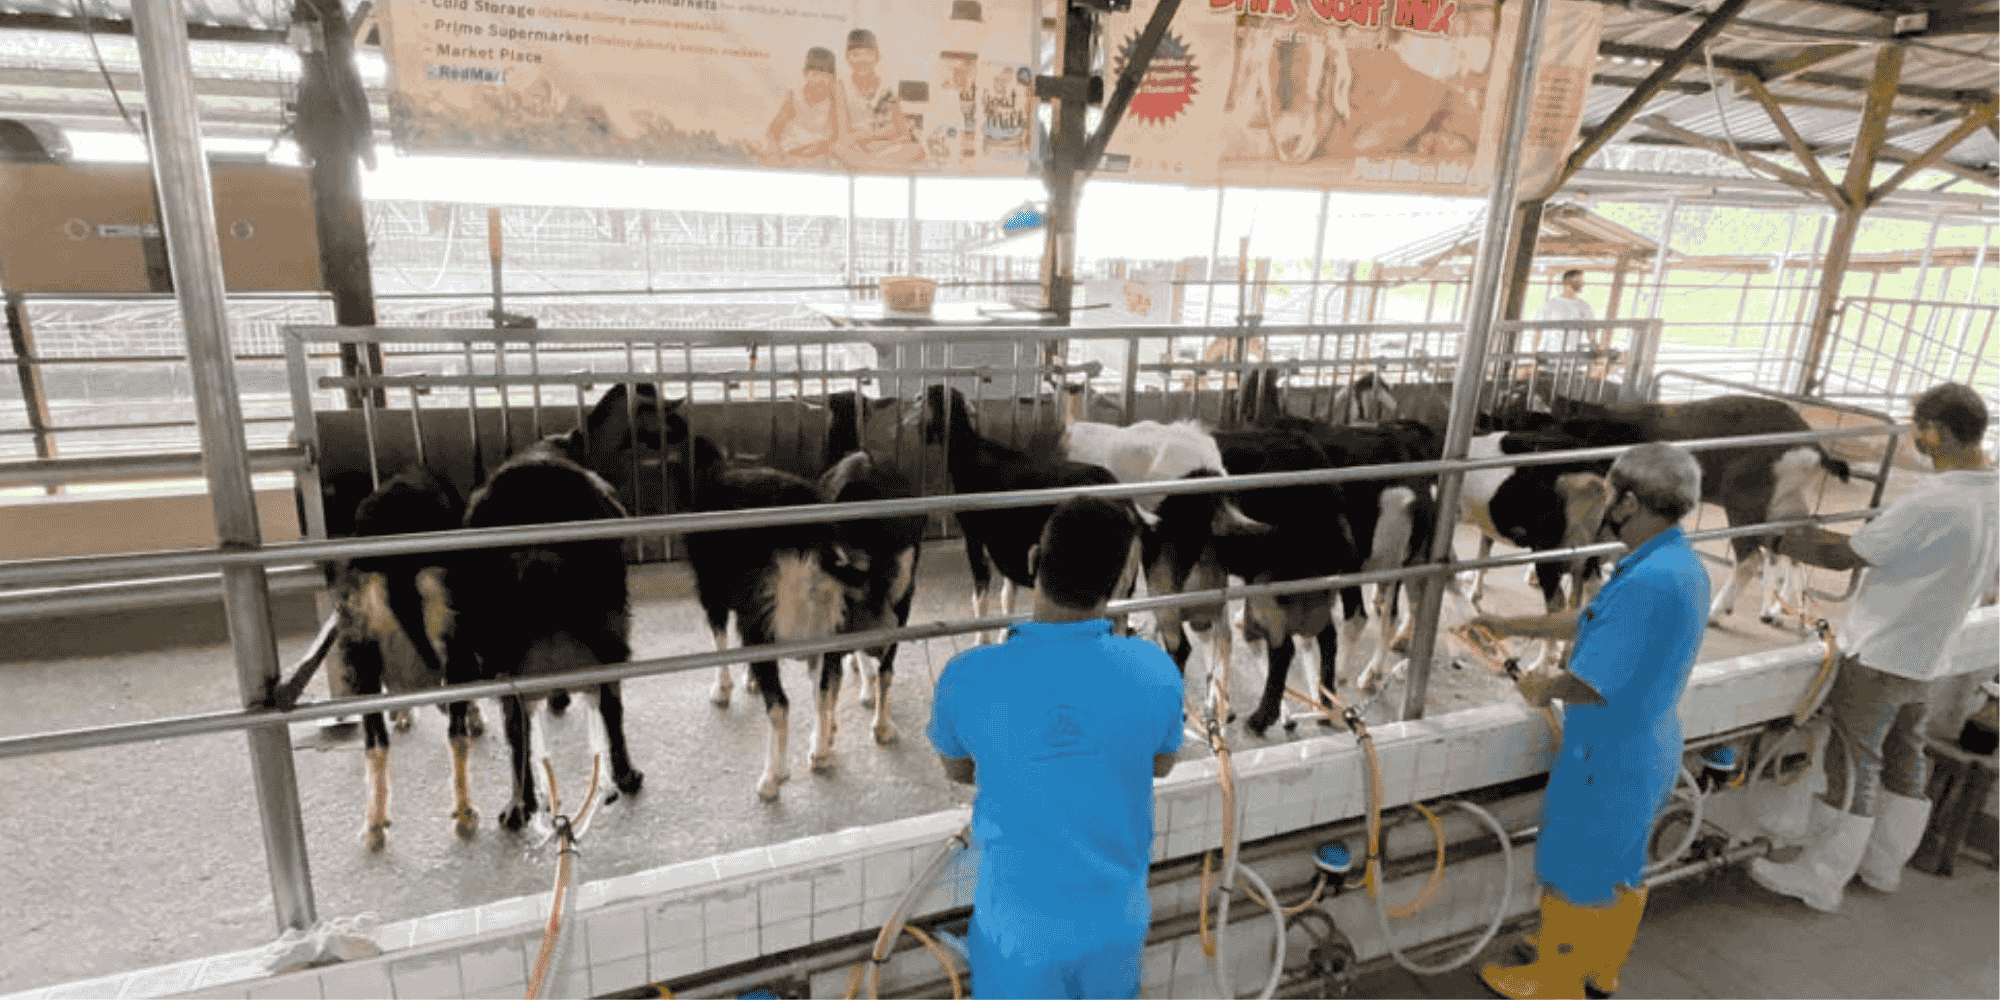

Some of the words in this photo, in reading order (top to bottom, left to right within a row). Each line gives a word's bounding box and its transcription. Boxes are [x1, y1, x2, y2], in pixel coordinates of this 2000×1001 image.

[474, 0, 535, 18] Storage
[435, 19, 483, 35] Prime
[489, 23, 589, 45] Supermarket
[437, 43, 494, 60] Market
[500, 48, 543, 63] Place
